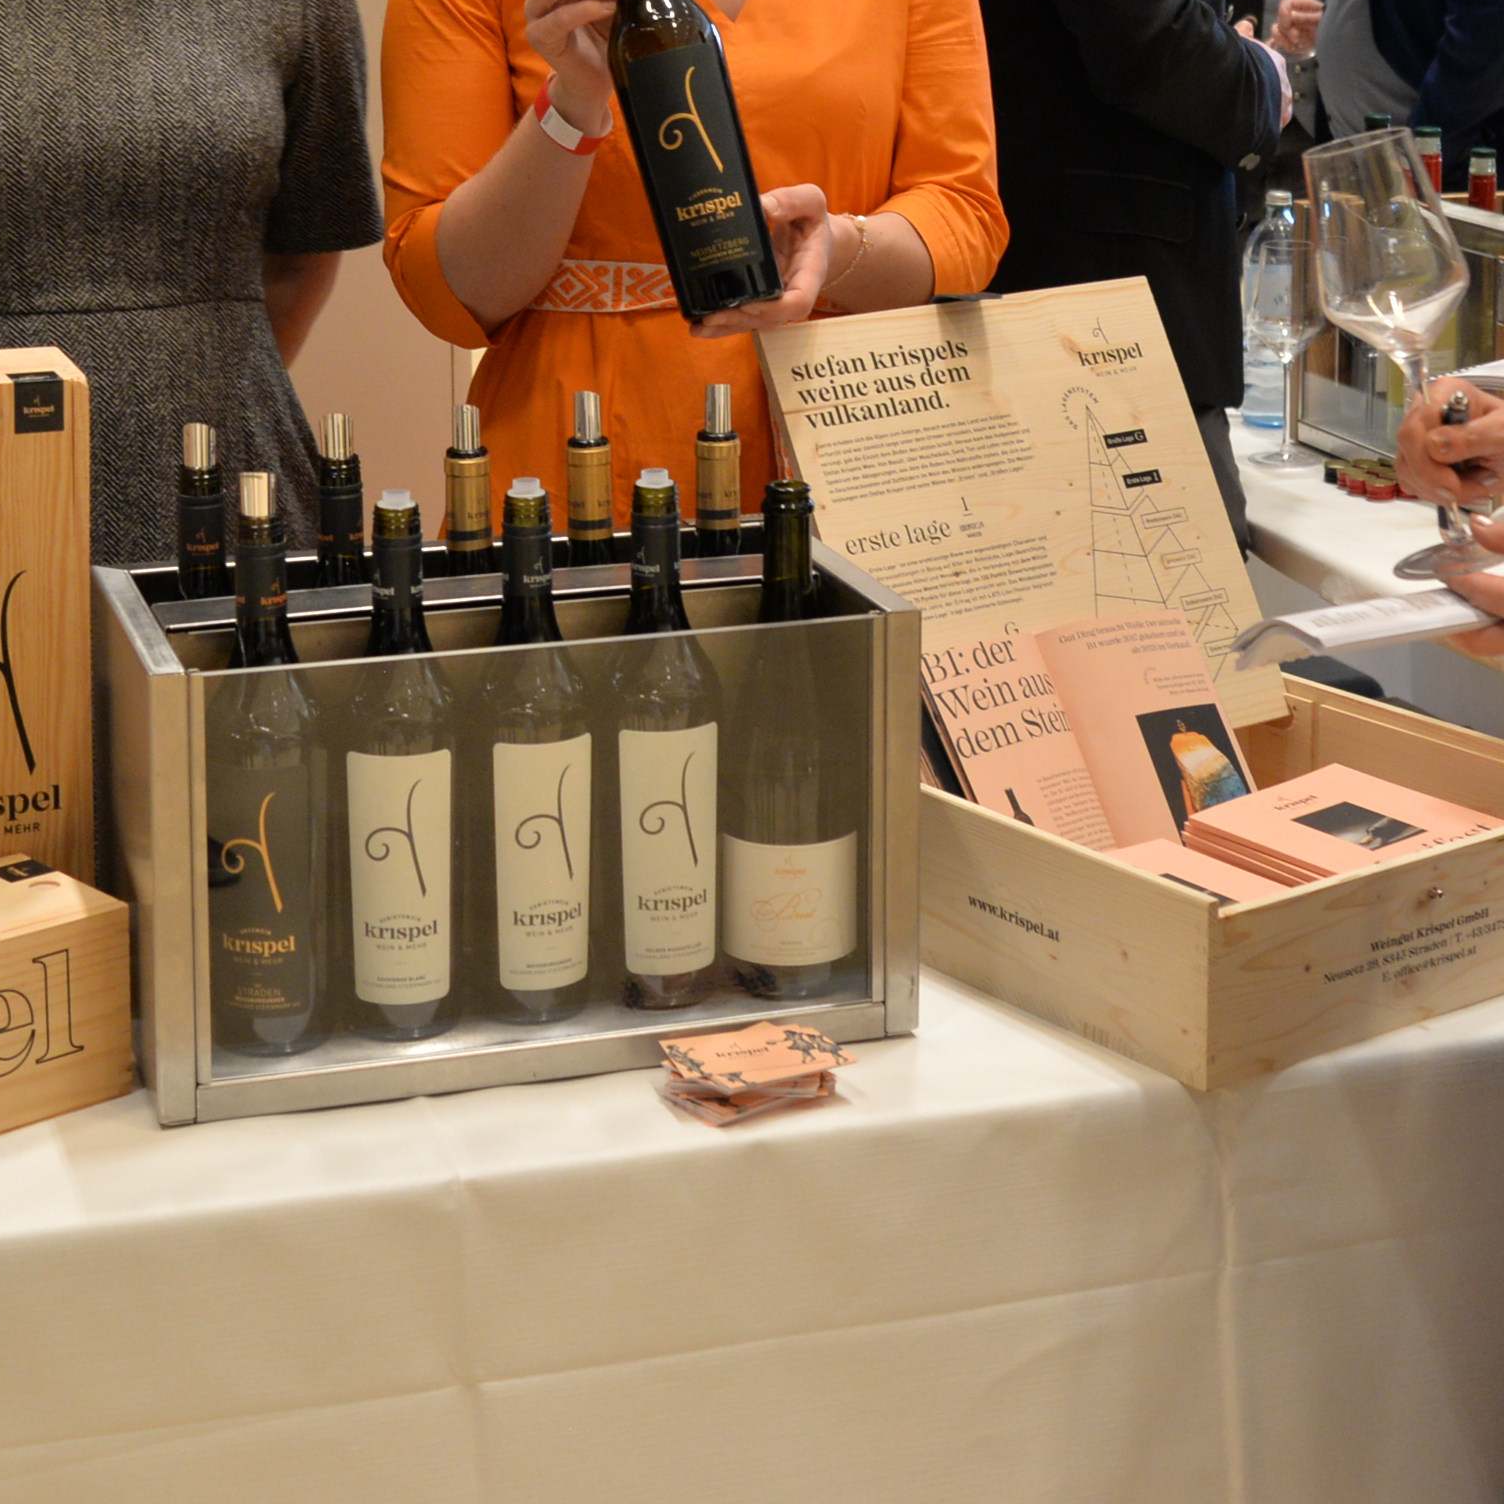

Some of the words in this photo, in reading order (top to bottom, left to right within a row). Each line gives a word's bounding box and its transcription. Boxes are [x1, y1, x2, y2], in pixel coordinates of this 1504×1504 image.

[675, 191, 742, 221] krispel
[791, 355, 868, 382] stefan
[869, 340, 969, 370] krispels
[1077, 342, 1143, 367] krispel
[797, 380, 869, 406] weine
[873, 373, 916, 394] aus
[920, 365, 971, 387] dem
[805, 390, 950, 430] vulkanland.
[845, 531, 901, 555] erste
[904, 520, 951, 545] lage
[1058, 633, 1076, 644] Gut
[972, 640, 1017, 671] der
[935, 678, 1018, 720] Wein
[1019, 673, 1055, 700] aus
[955, 728, 1023, 759] dem
[4, 822, 41, 835] MEHR
[513, 902, 582, 927] krispel
[637, 888, 708, 912] krispel
[364, 919, 438, 943] krispel
[968, 895, 1060, 942] www.krispel.at
[1370, 932, 1414, 952] Weingut
[1416, 917, 1456, 939] Krispel
[1456, 907, 1489, 926] GmbH
[223, 934, 296, 958] krispel
[1408, 939, 1447, 959] Straden
